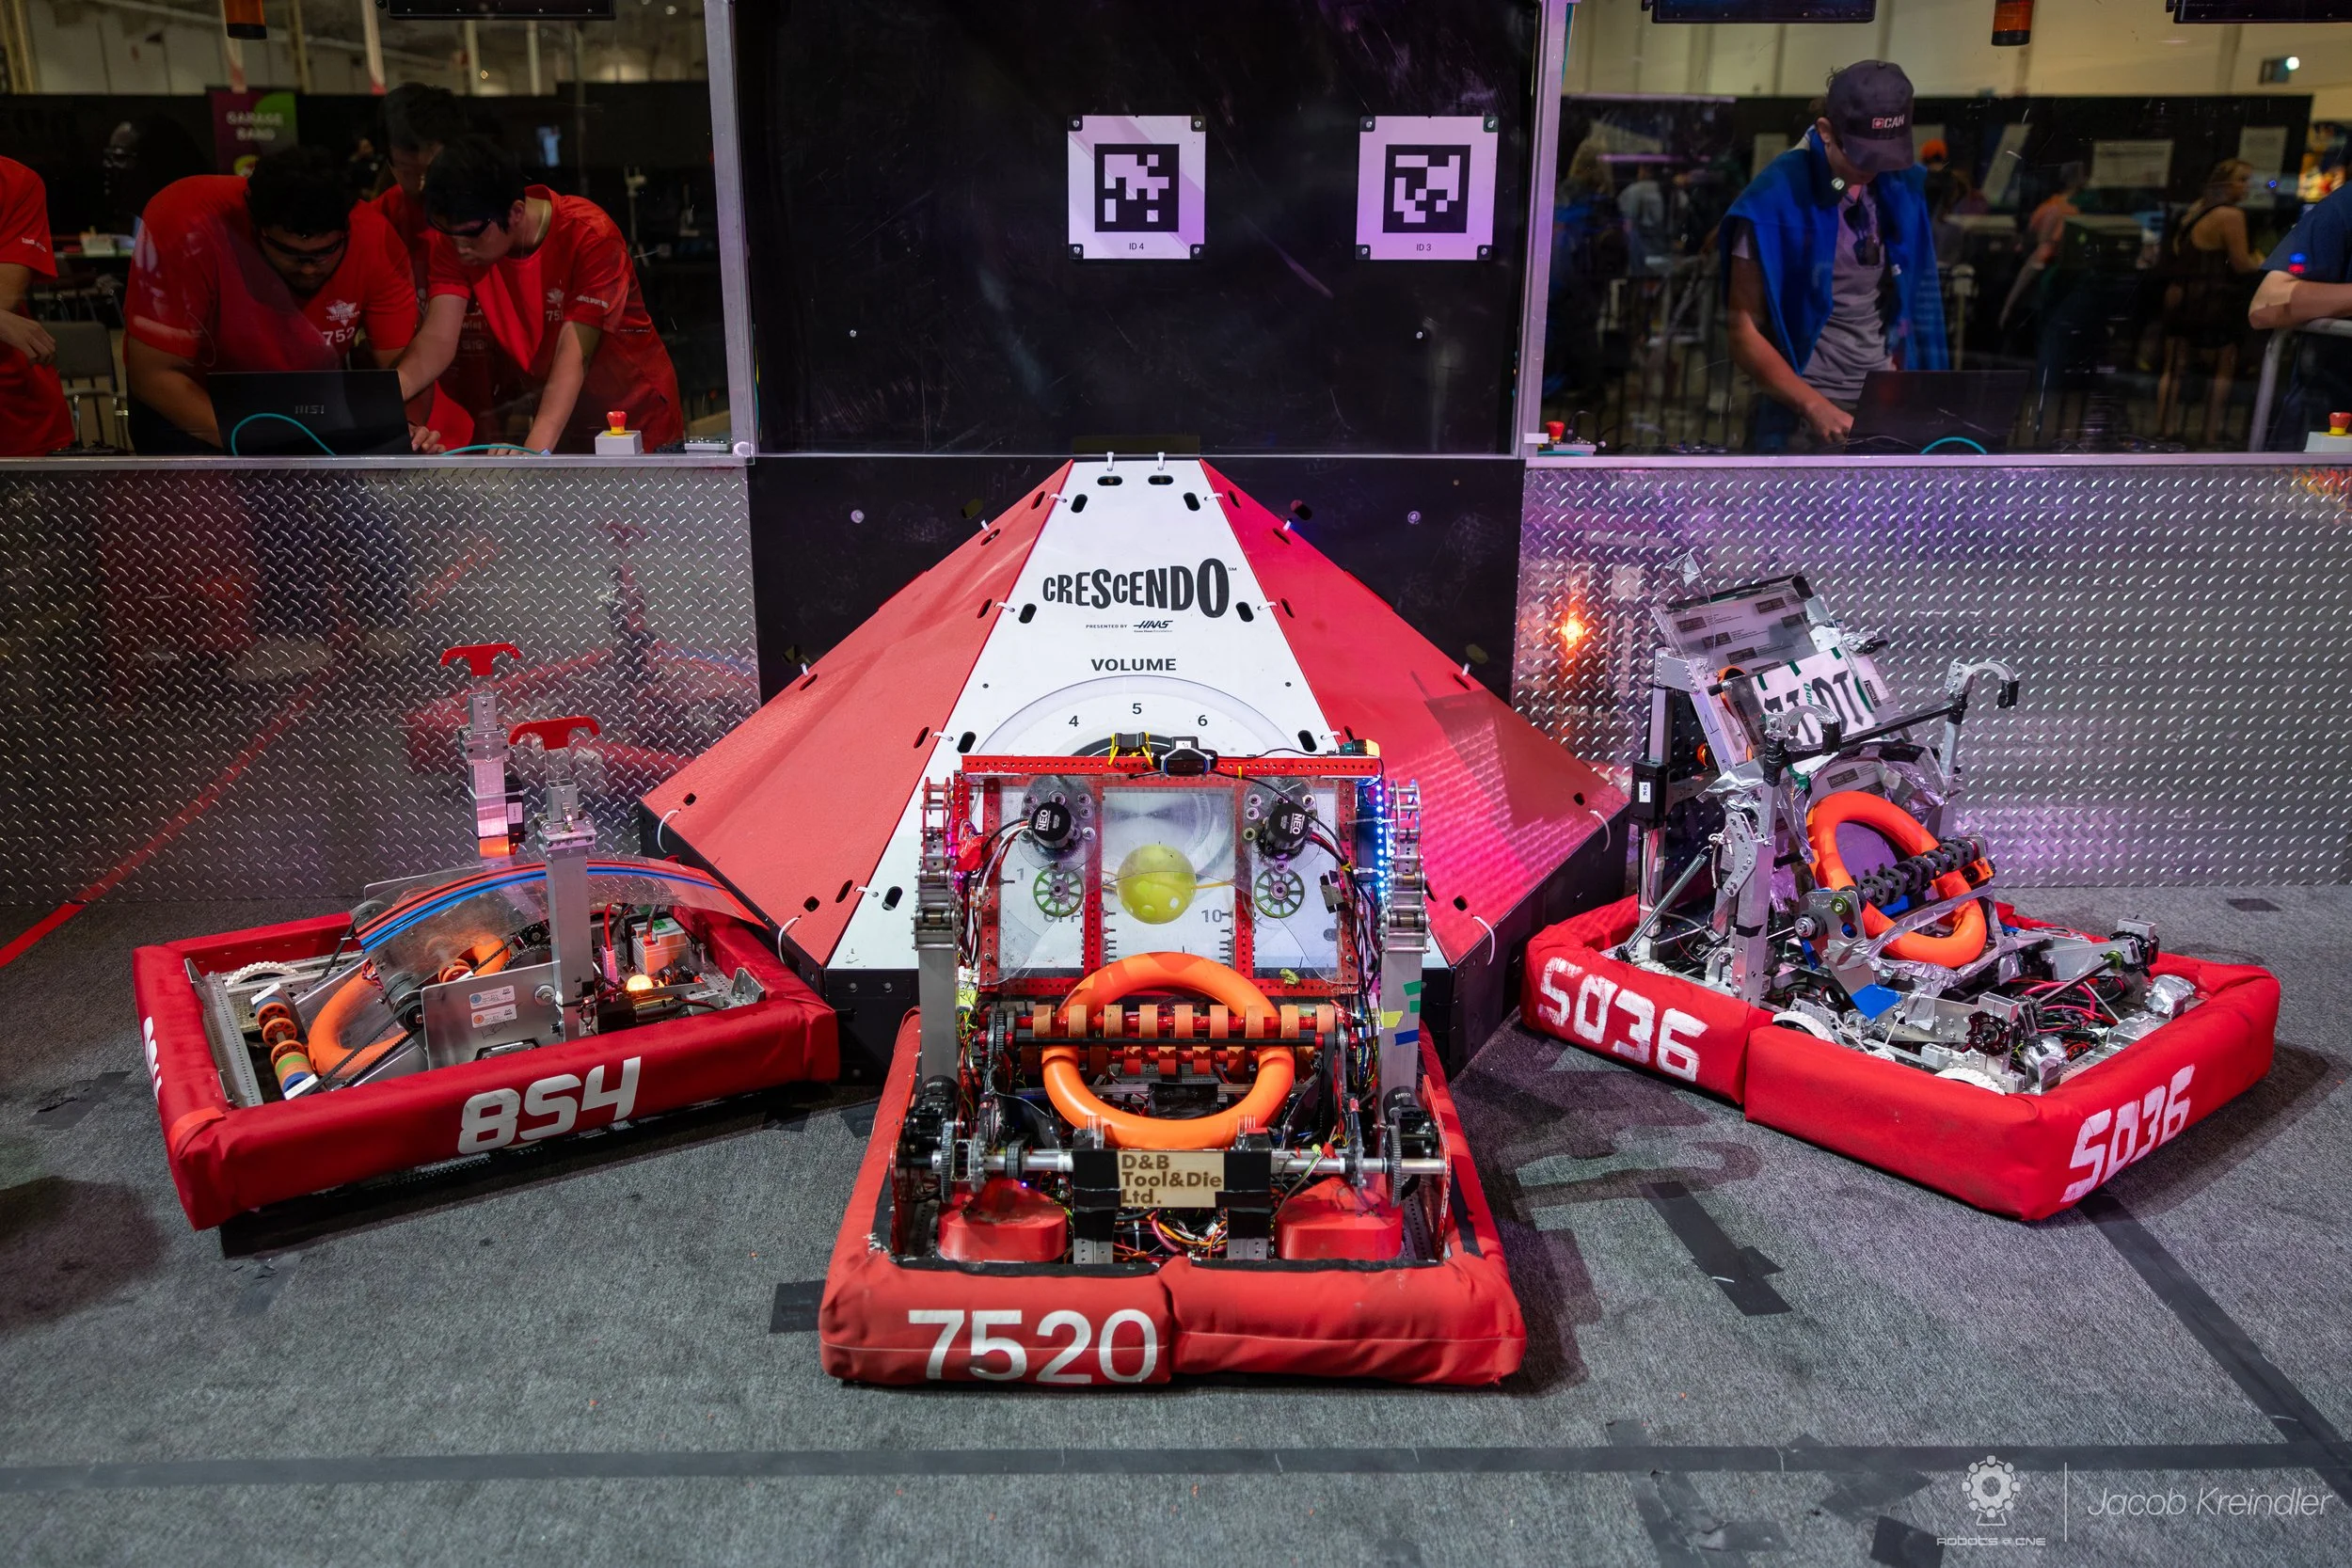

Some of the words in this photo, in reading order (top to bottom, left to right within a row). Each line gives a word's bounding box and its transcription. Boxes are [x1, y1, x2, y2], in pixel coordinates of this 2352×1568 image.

[1129, 242, 1138, 251] ID
[1138, 242, 1145, 251] 4
[1416, 243, 1425, 252] ID
[1425, 243, 1433, 252] 3
[546, 310, 564, 322] 75
[1042, 558, 1230, 618] CRESCENDO
[1133, 620, 1173, 629] HAAS
[1090, 658, 1177, 672] VOLUME
[1132, 703, 1142, 715] 5
[1068, 715, 1079, 727] 4
[1198, 714, 1208, 727] 6
[1038, 809, 1048, 832] NEO
[1292, 813, 1303, 835] NEO
[1016, 867, 1025, 881] 1
[1200, 909, 1223, 923] 10
[1537, 956, 1709, 1083] 5036
[1394, 1092, 1411, 1101] NEO
[457, 1055, 642, 1155] 854
[2059, 1063, 2196, 1203] 5036
[1121, 1154, 1170, 1170] D&B
[1121, 1171, 1223, 1188] Tool&Die
[1121, 1188, 1162, 1204] Ltd.
[908, 1308, 1158, 1383] 7520
